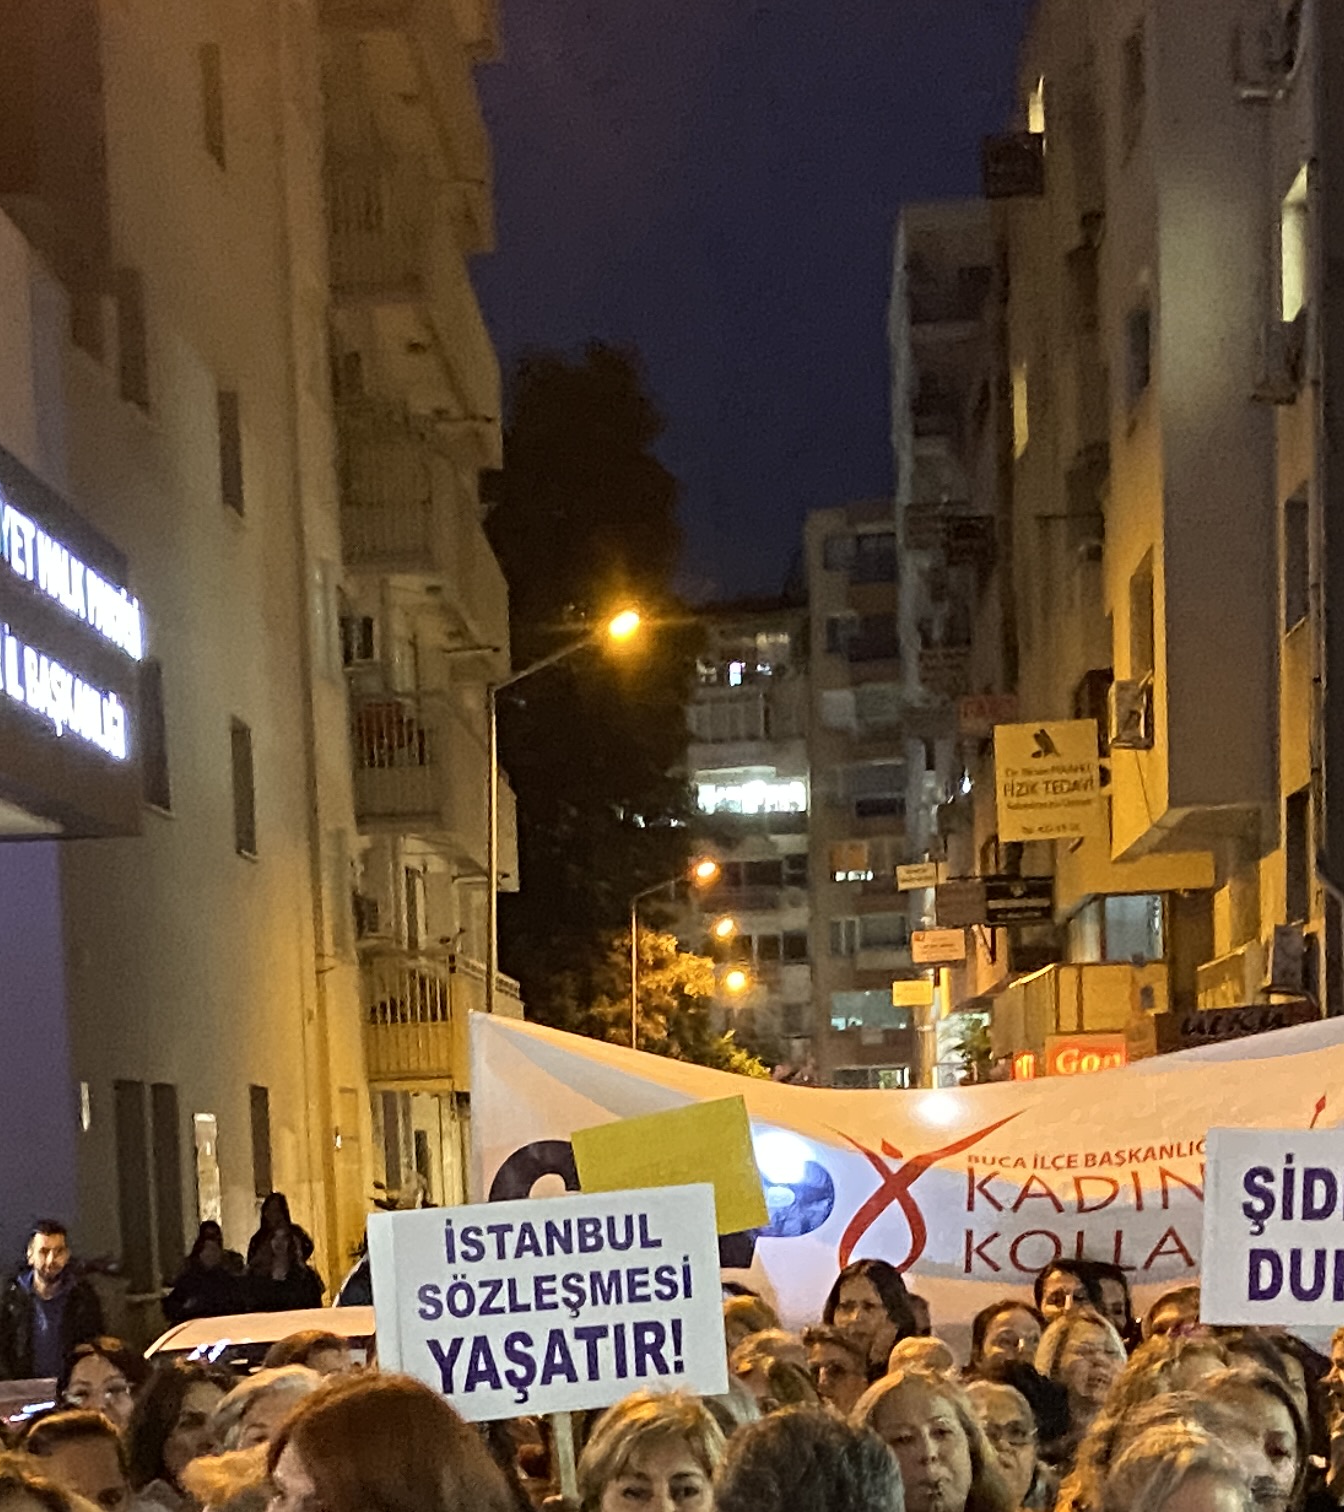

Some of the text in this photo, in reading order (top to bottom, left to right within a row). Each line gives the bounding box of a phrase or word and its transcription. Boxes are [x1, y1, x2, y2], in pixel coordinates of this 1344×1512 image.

[1033, 1152, 1079, 1171] İLÇE
[1083, 1138, 1206, 1169] BAŞKANLIĞ
[966, 1163, 1205, 1214] KADIN
[444, 1213, 663, 1265] İSTANBUL
[417, 1255, 693, 1319] SÖZLEŞMESİ
[426, 1318, 685, 1404] YAŞATIR!
